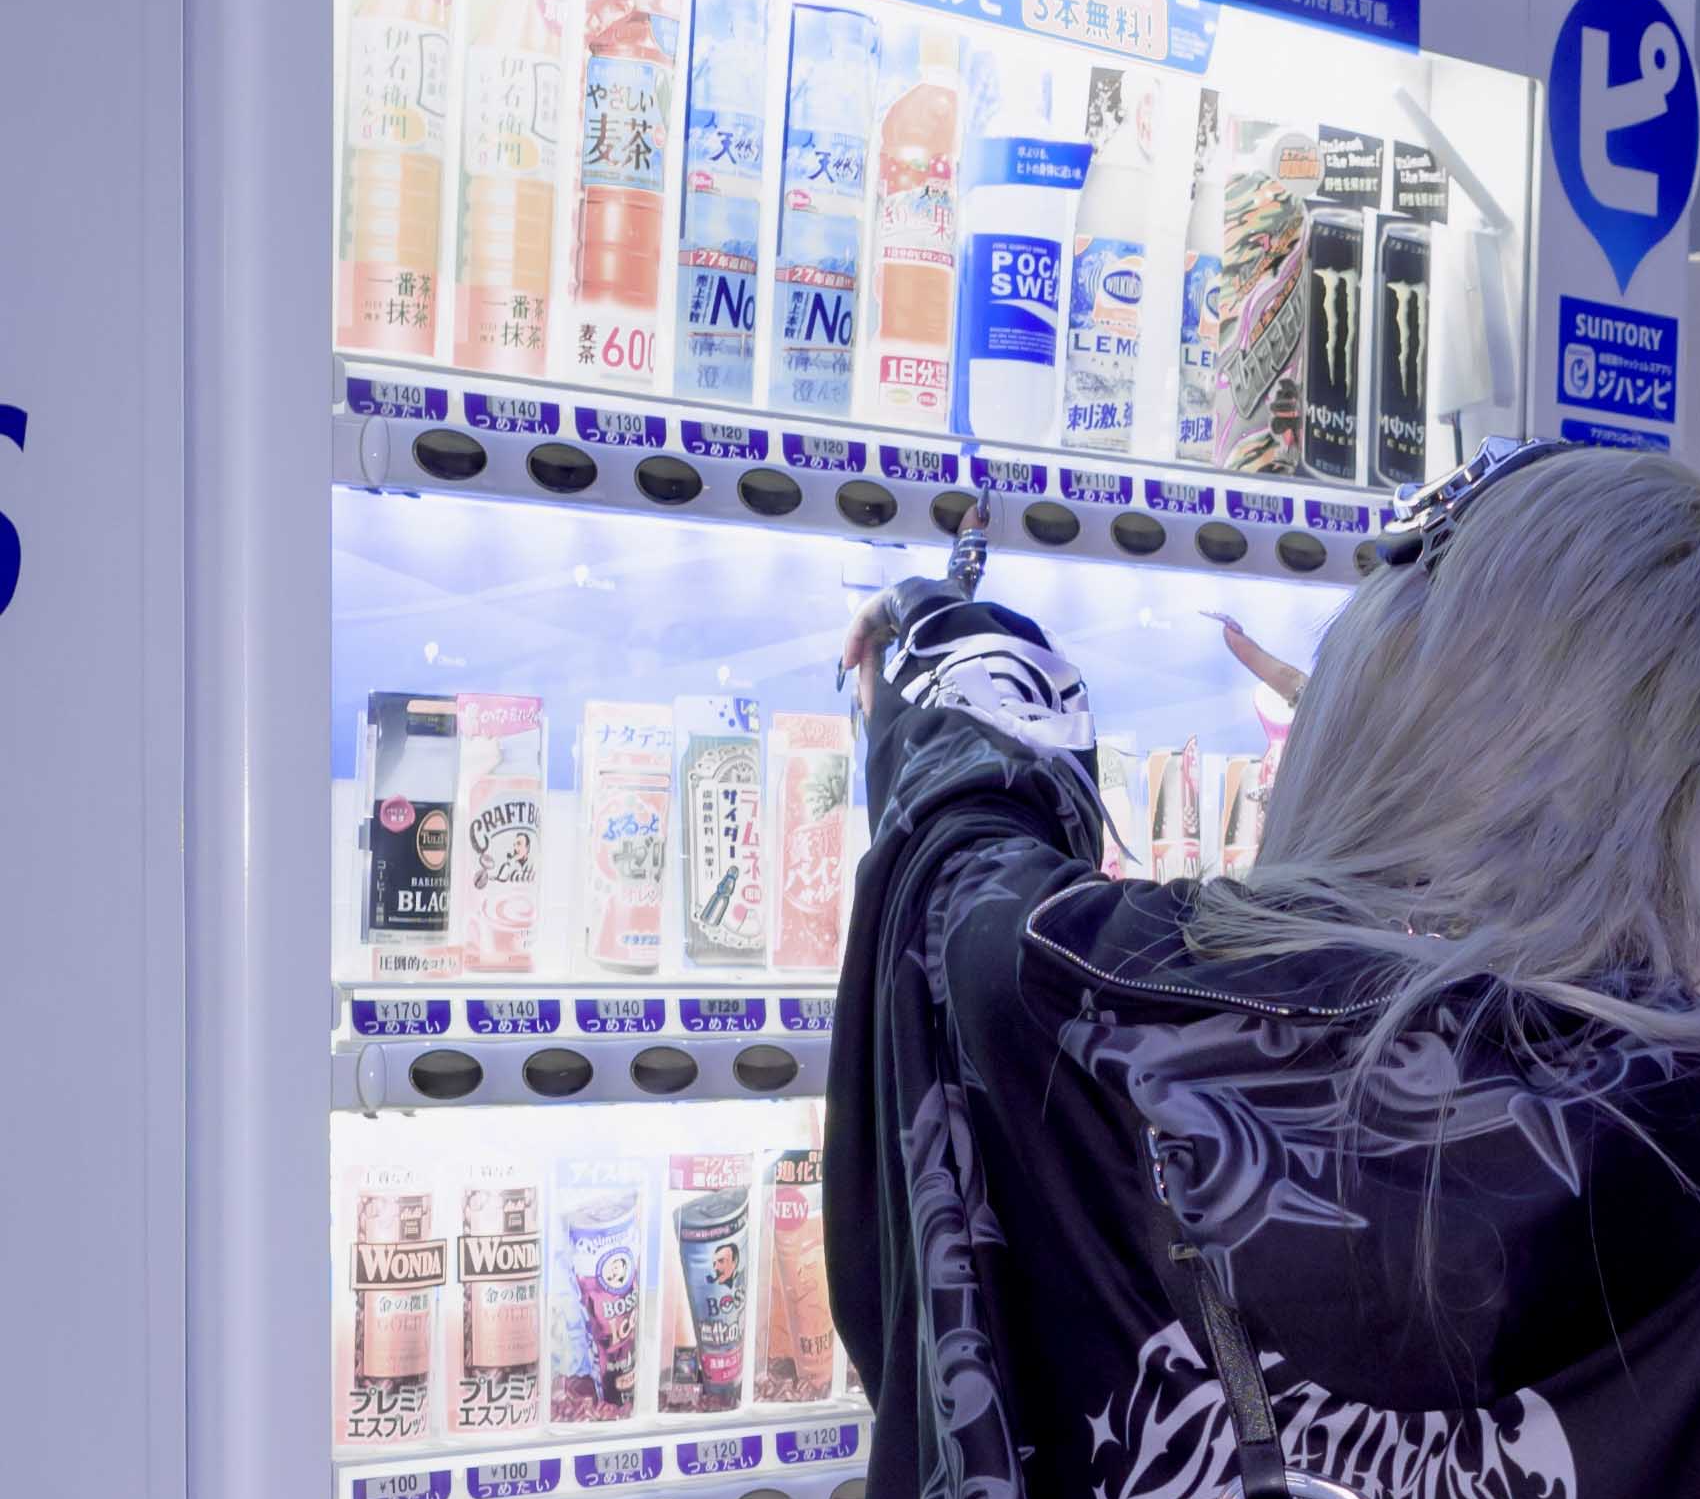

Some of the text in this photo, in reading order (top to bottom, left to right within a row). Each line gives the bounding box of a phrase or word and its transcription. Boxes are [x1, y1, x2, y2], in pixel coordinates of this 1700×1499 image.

[586, 83, 654, 114] やさしい
[585, 112, 654, 172] 麦茶
[990, 272, 1060, 300] SWE
[1575, 313, 1663, 351] SUNTORY
[1184, 346, 1216, 369] LE
[380, 386, 421, 404] ¥140
[359, 400, 438, 420] つめたい
[498, 400, 537, 418] ¥140
[475, 414, 550, 435] つめたい
[604, 412, 643, 433] ¥130
[585, 427, 658, 448] つめたい
[710, 423, 743, 442] ¥120
[691, 439, 759, 461] つめたい
[812, 439, 844, 456] ¥120
[792, 451, 858, 472] つめたい
[904, 450, 940, 471] ¥160
[888, 464, 950, 484] つめたい
[979, 475, 1040, 494] つめたい
[1067, 487, 1126, 505] つめたい
[1152, 497, 1208, 515] つめたい
[1232, 507, 1288, 525] つめたい
[1311, 516, 1364, 534] つめたい
[469, 800, 526, 856] CRAFT
[381, 1002, 422, 1019] ¥170
[497, 1001, 535, 1017] ¥140
[603, 1000, 641, 1017] ¥140
[363, 1019, 441, 1034] つめたい
[478, 1019, 552, 1034] つめたい
[586, 1019, 657, 1033] つめたい
[690, 1018, 758, 1032] つめたい
[359, 1242, 441, 1282] WONDA
[804, 1427, 838, 1445] ¥120
[703, 1439, 738, 1459] ¥120
[786, 1444, 850, 1463] つめたい
[491, 1462, 529, 1479] ¥100
[604, 1453, 640, 1470] ¥120
[687, 1455, 754, 1473] つめたい
[380, 1474, 418, 1494] ¥100
[585, 1467, 654, 1486] つめたい
[478, 1478, 551, 1499] つめたい
